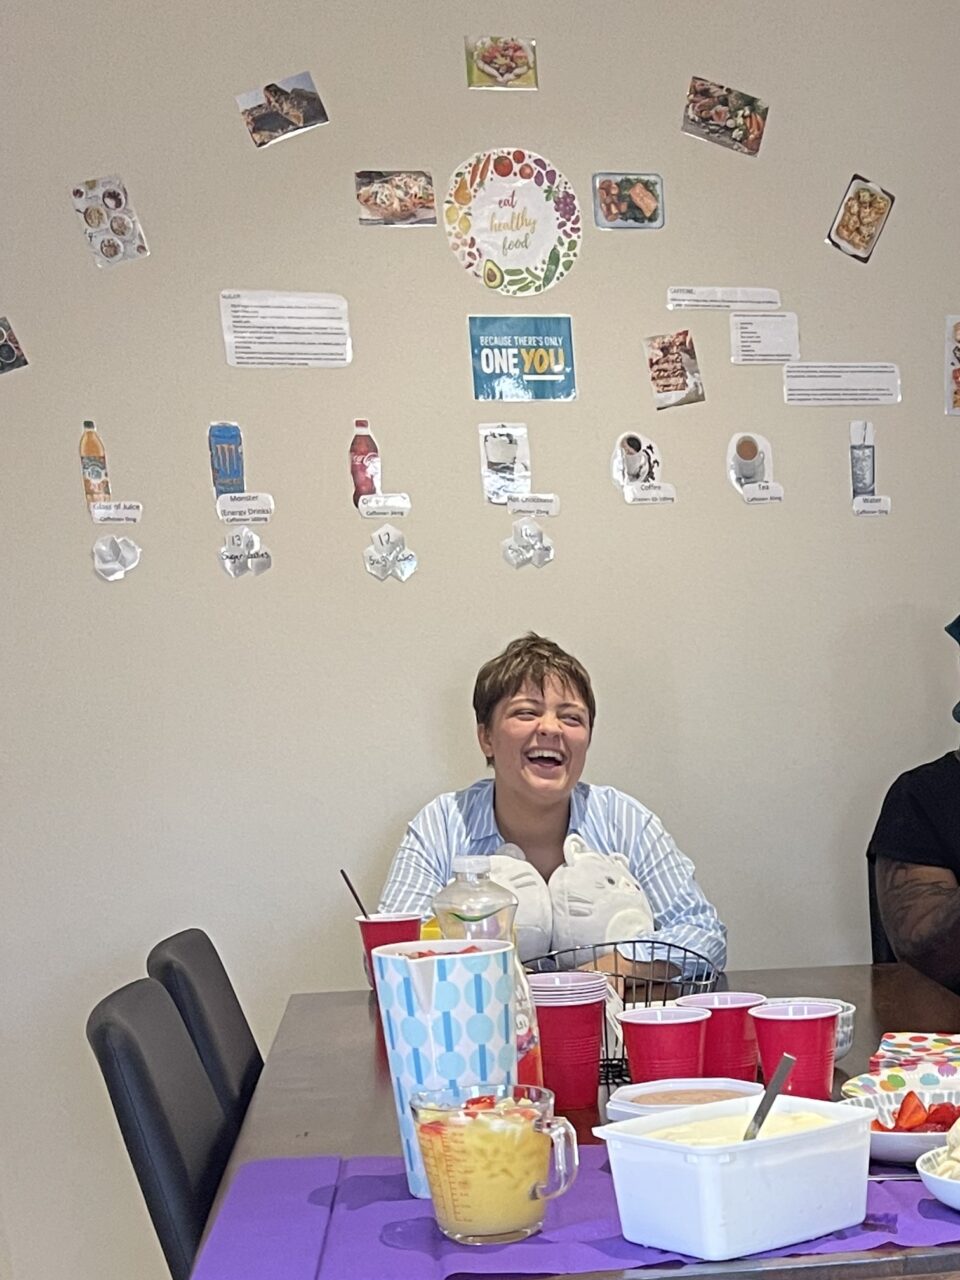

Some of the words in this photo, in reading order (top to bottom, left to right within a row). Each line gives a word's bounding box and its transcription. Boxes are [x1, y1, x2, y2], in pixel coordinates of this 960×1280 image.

[498, 189, 518, 209] eat
[490, 206, 537, 235] healthy
[502, 232, 530, 256] food
[479, 336, 513, 347] BECAUSE
[513, 336, 544, 347] THERE'S
[544, 336, 564, 347] ONLY
[480, 347, 519, 375] ONE
[520, 347, 565, 375] YOU
[640, 483, 662, 492] Coffee
[758, 483, 770, 491] Tea
[507, 495, 520, 503] Hot
[92, 503, 112, 511] Glass
[123, 502, 140, 511] Juice
[231, 534, 242, 547] 13
[378, 531, 391, 547] 12
